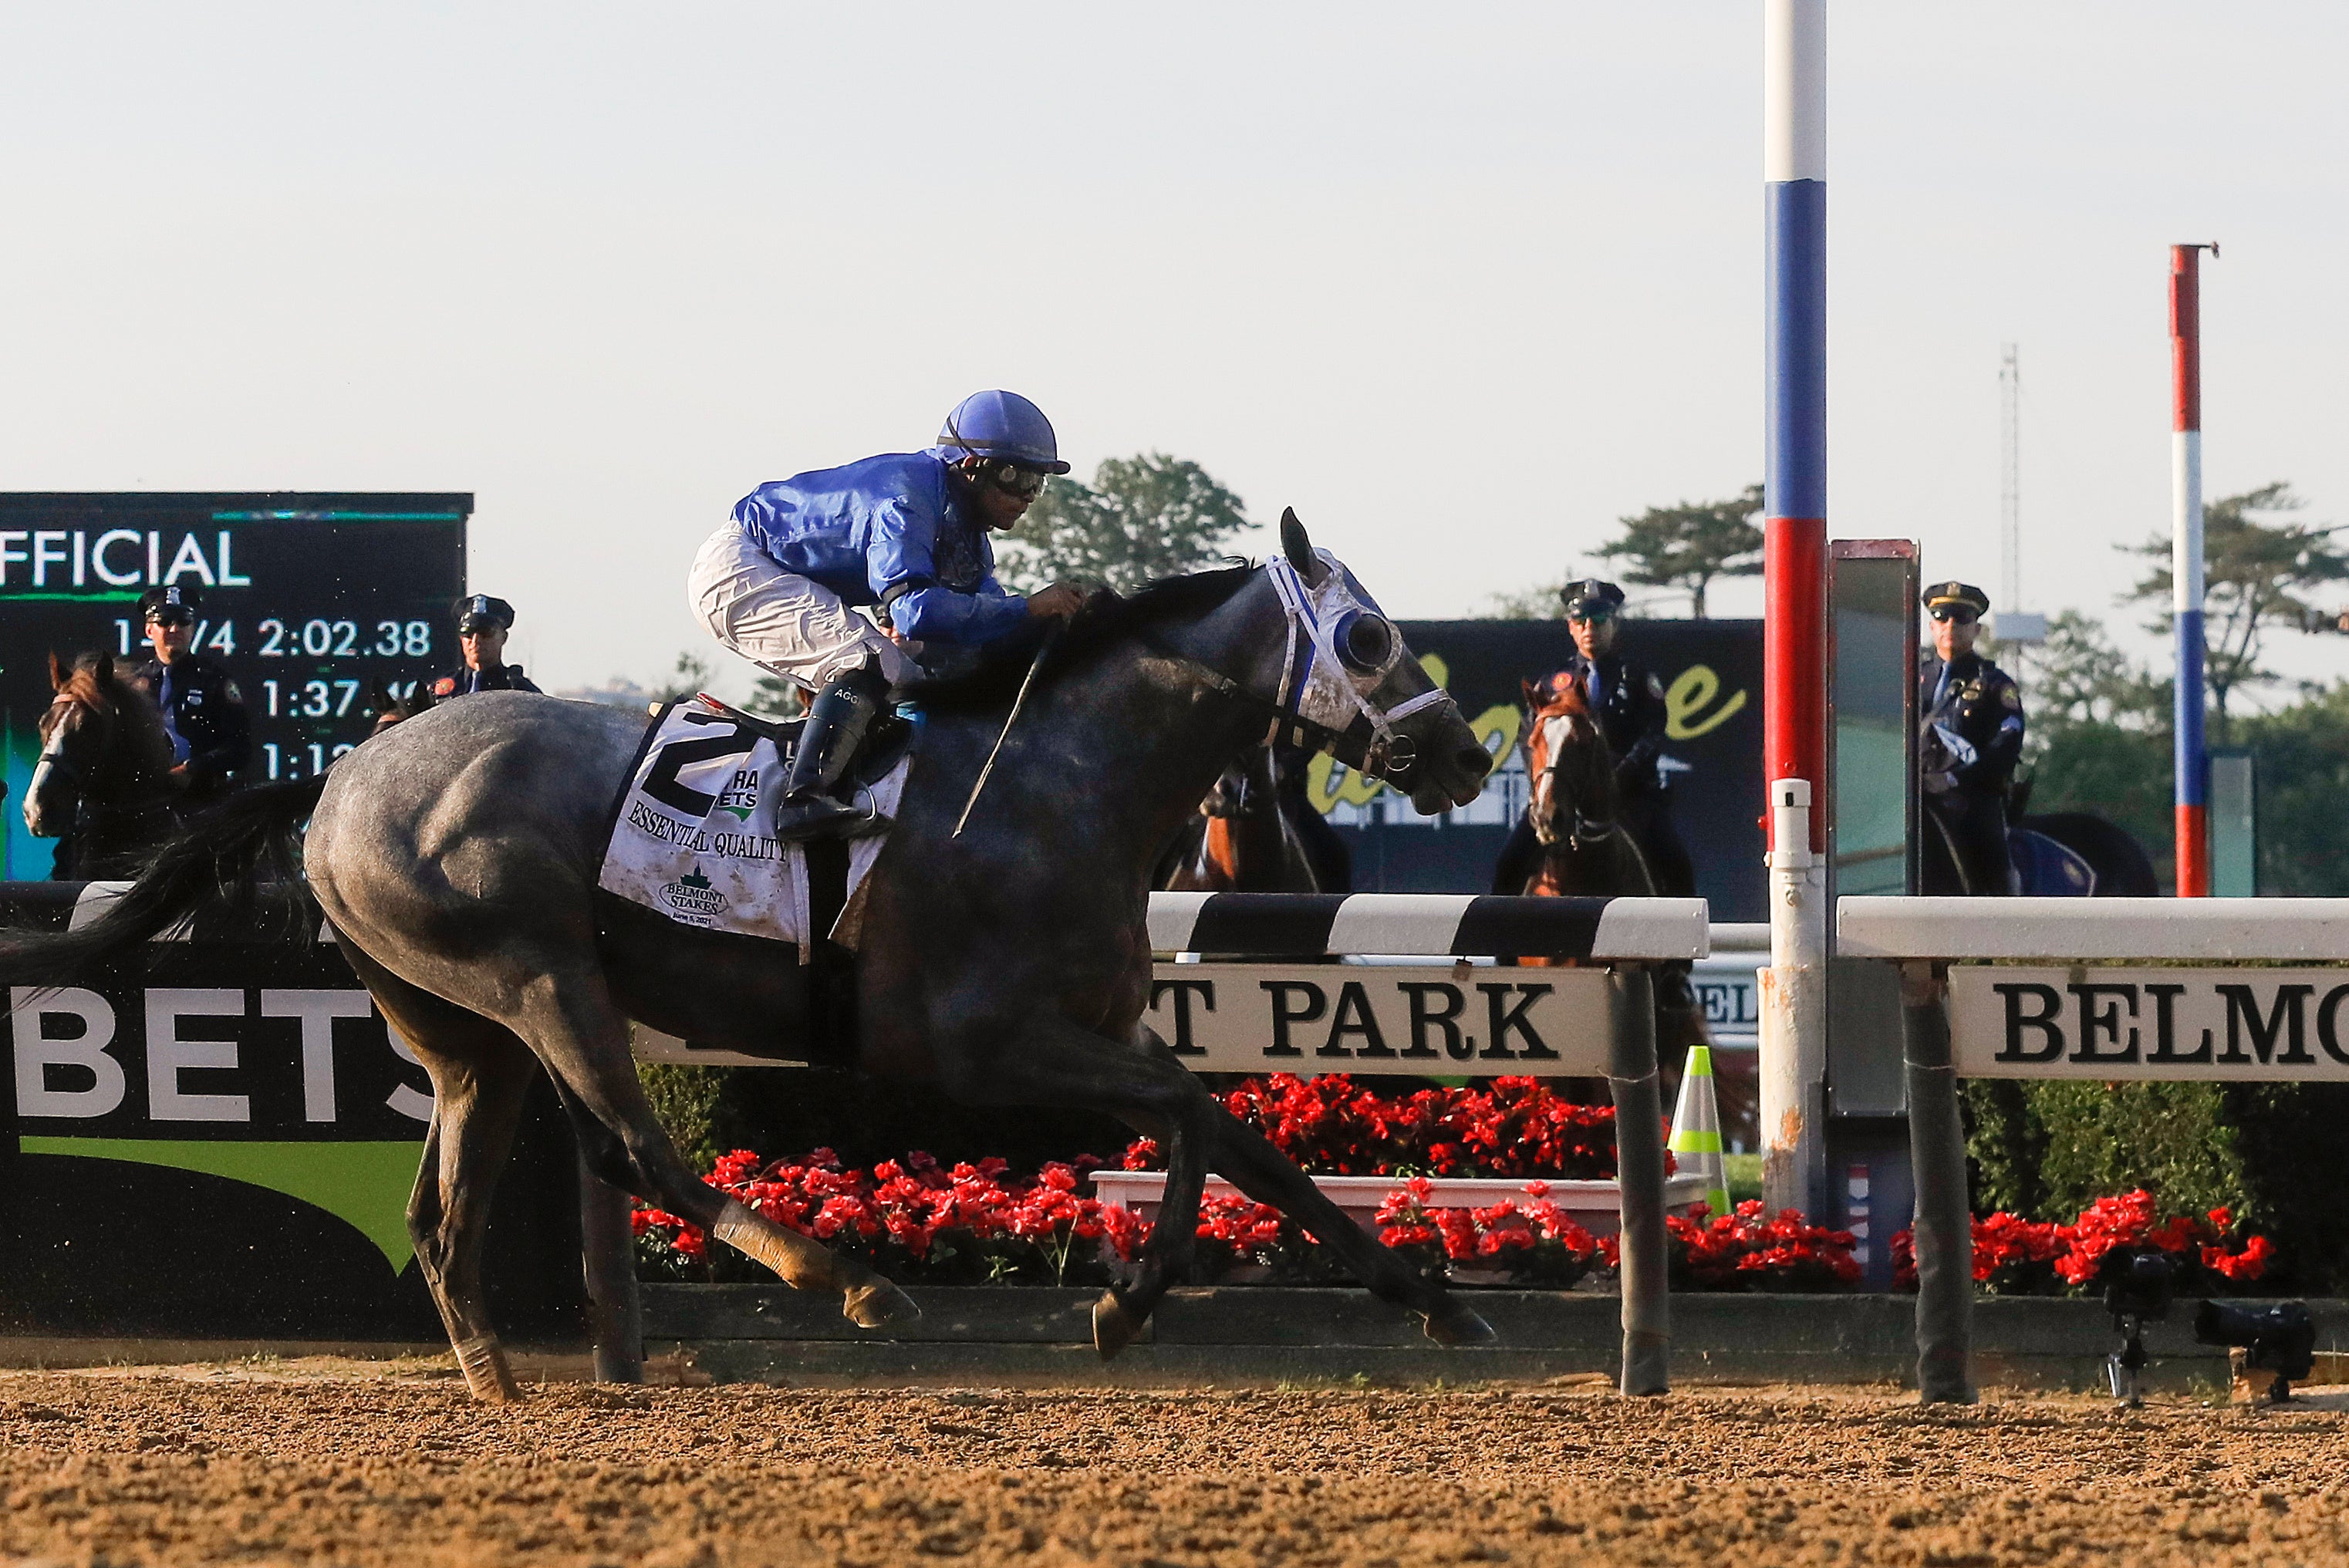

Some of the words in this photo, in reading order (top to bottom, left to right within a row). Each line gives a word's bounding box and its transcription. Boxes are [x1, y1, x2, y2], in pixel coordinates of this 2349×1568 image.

[114, 619, 236, 656] 1-/4
[258, 619, 431, 656] 2:02.38
[262, 679, 418, 717] 1:37.
[640, 712, 762, 818] 2
[725, 770, 758, 790] RA
[716, 792, 758, 808] ETS
[628, 800, 710, 851] ESSENTIAL
[714, 832, 785, 862] QUALITY
[667, 883, 725, 903] BELMONT
[670, 895, 718, 916] STAKES
[673, 912, 688, 920] June
[696, 916, 711, 925] 2021
[1259, 980, 1559, 1061] PARK
